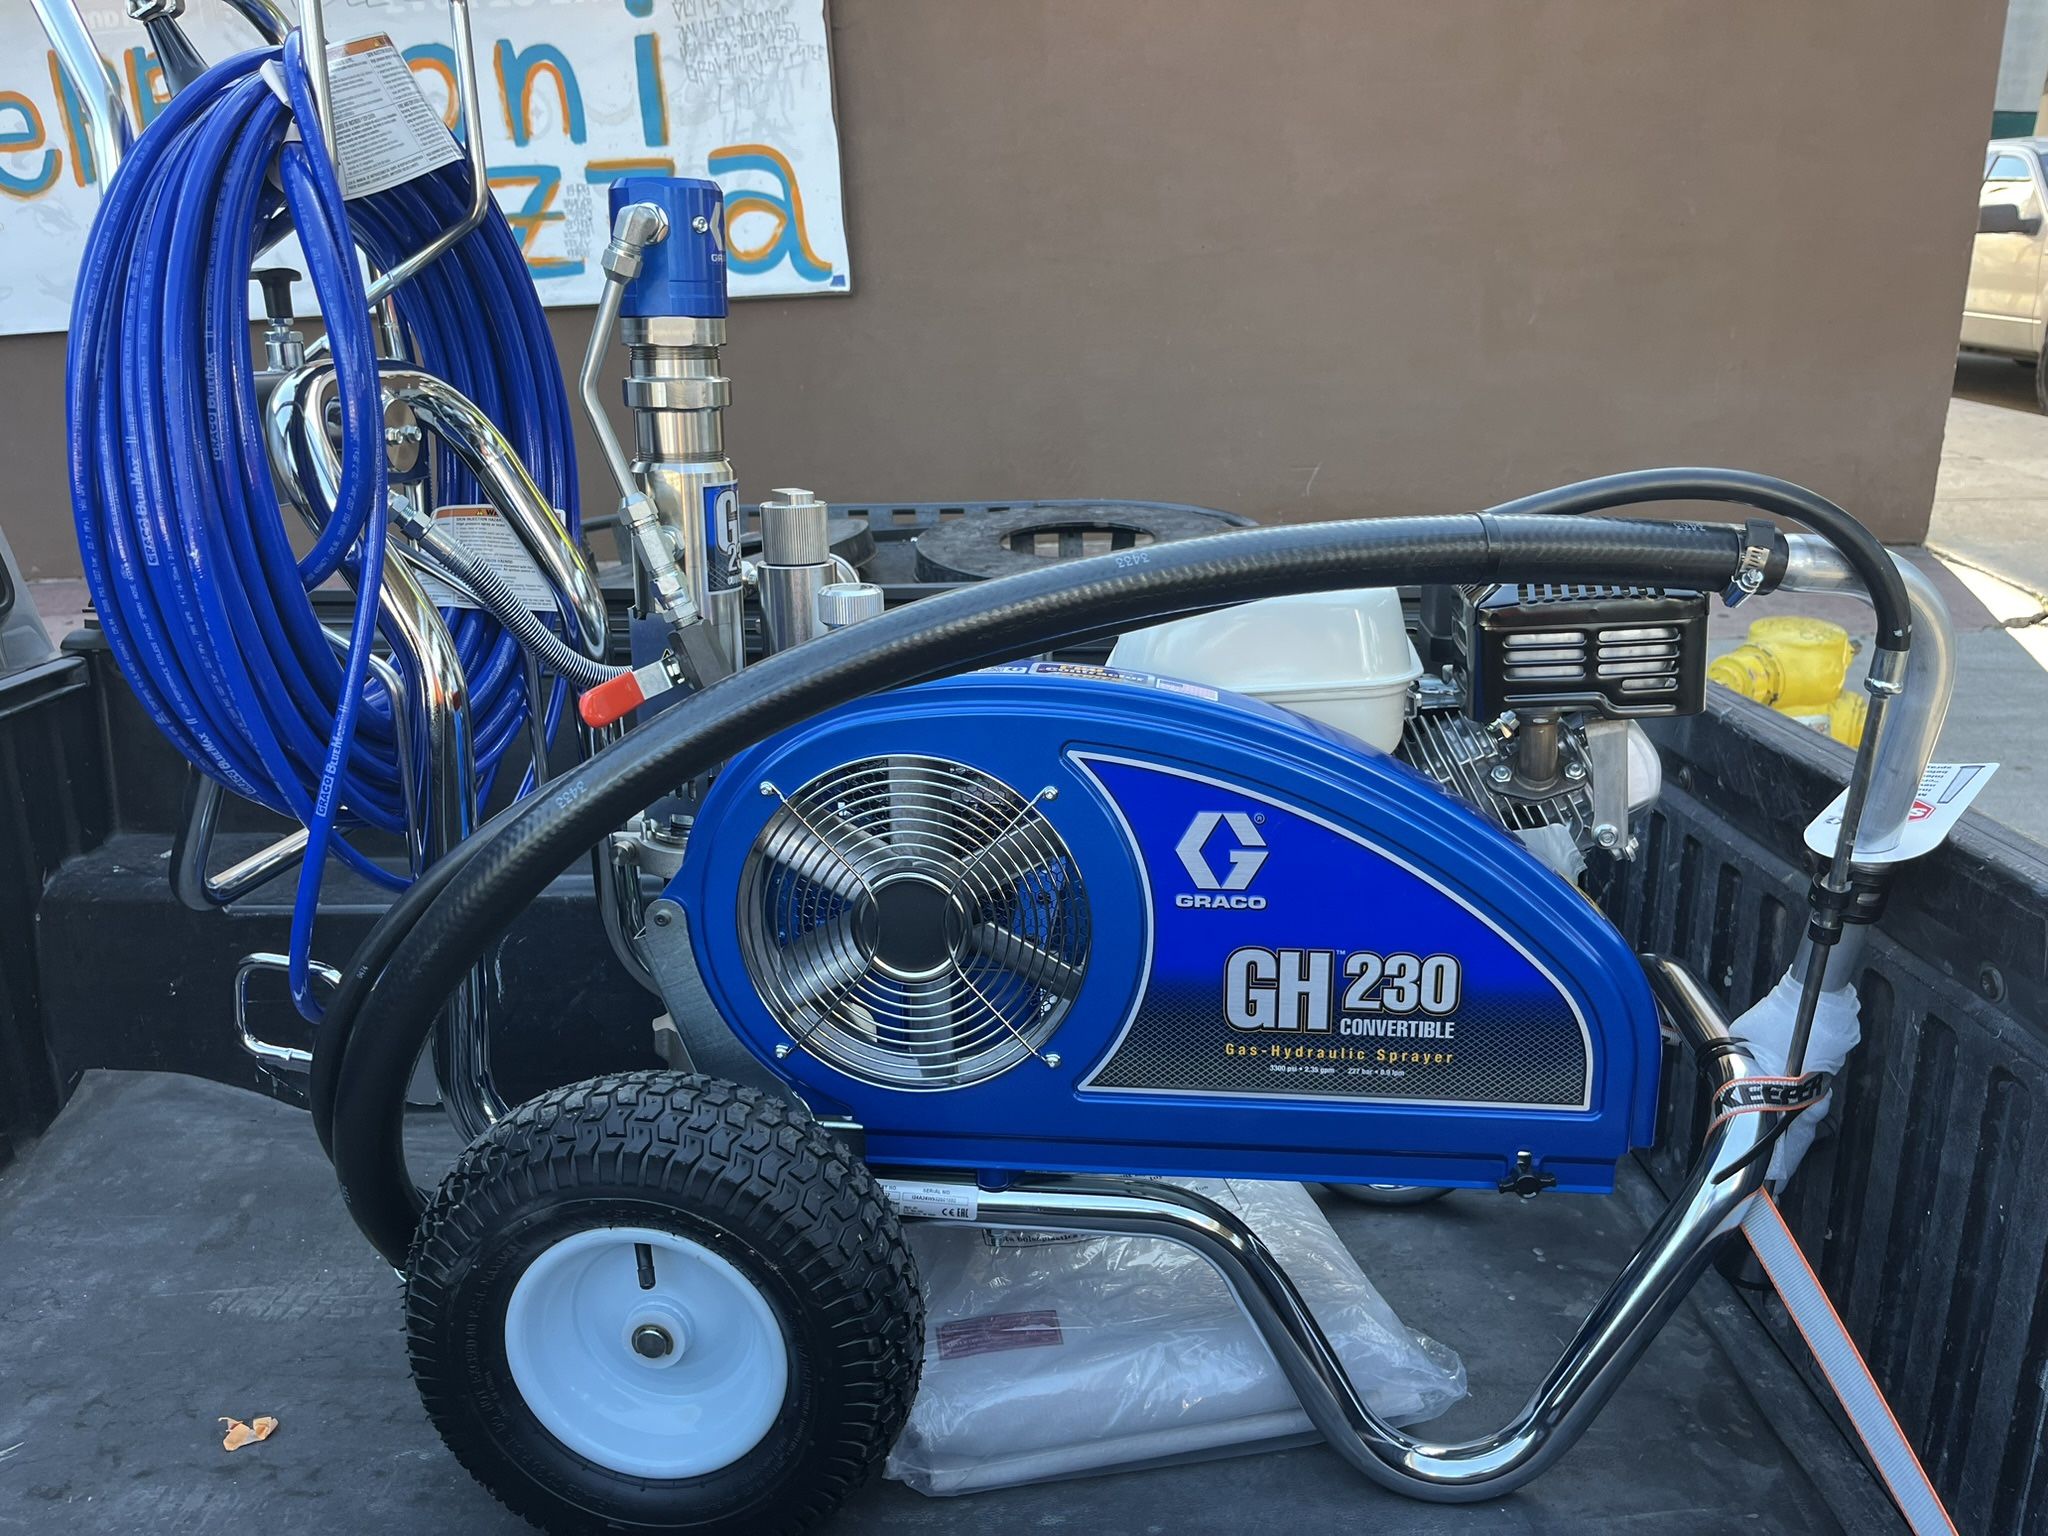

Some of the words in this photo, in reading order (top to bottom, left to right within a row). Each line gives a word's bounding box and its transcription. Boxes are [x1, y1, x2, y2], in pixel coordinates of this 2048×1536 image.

[208, 413, 222, 460] GRACO
[138, 518, 159, 566] GRACO
[1115, 552, 1151, 568] 3433
[142, 621, 155, 640] PAINT
[315, 775, 334, 817] GRACO
[553, 779, 587, 809] 3433
[1175, 893, 1267, 910] GRACO
[1223, 946, 1335, 1034] GH
[1342, 951, 1462, 1016] 230
[1340, 1018, 1455, 1039] CONVERTIBLE
[1225, 1042, 1366, 1062] Gas-Hydraulic
[1376, 1046, 1454, 1065] Sprayer
[1320, 1067, 1335, 1075] gpm
